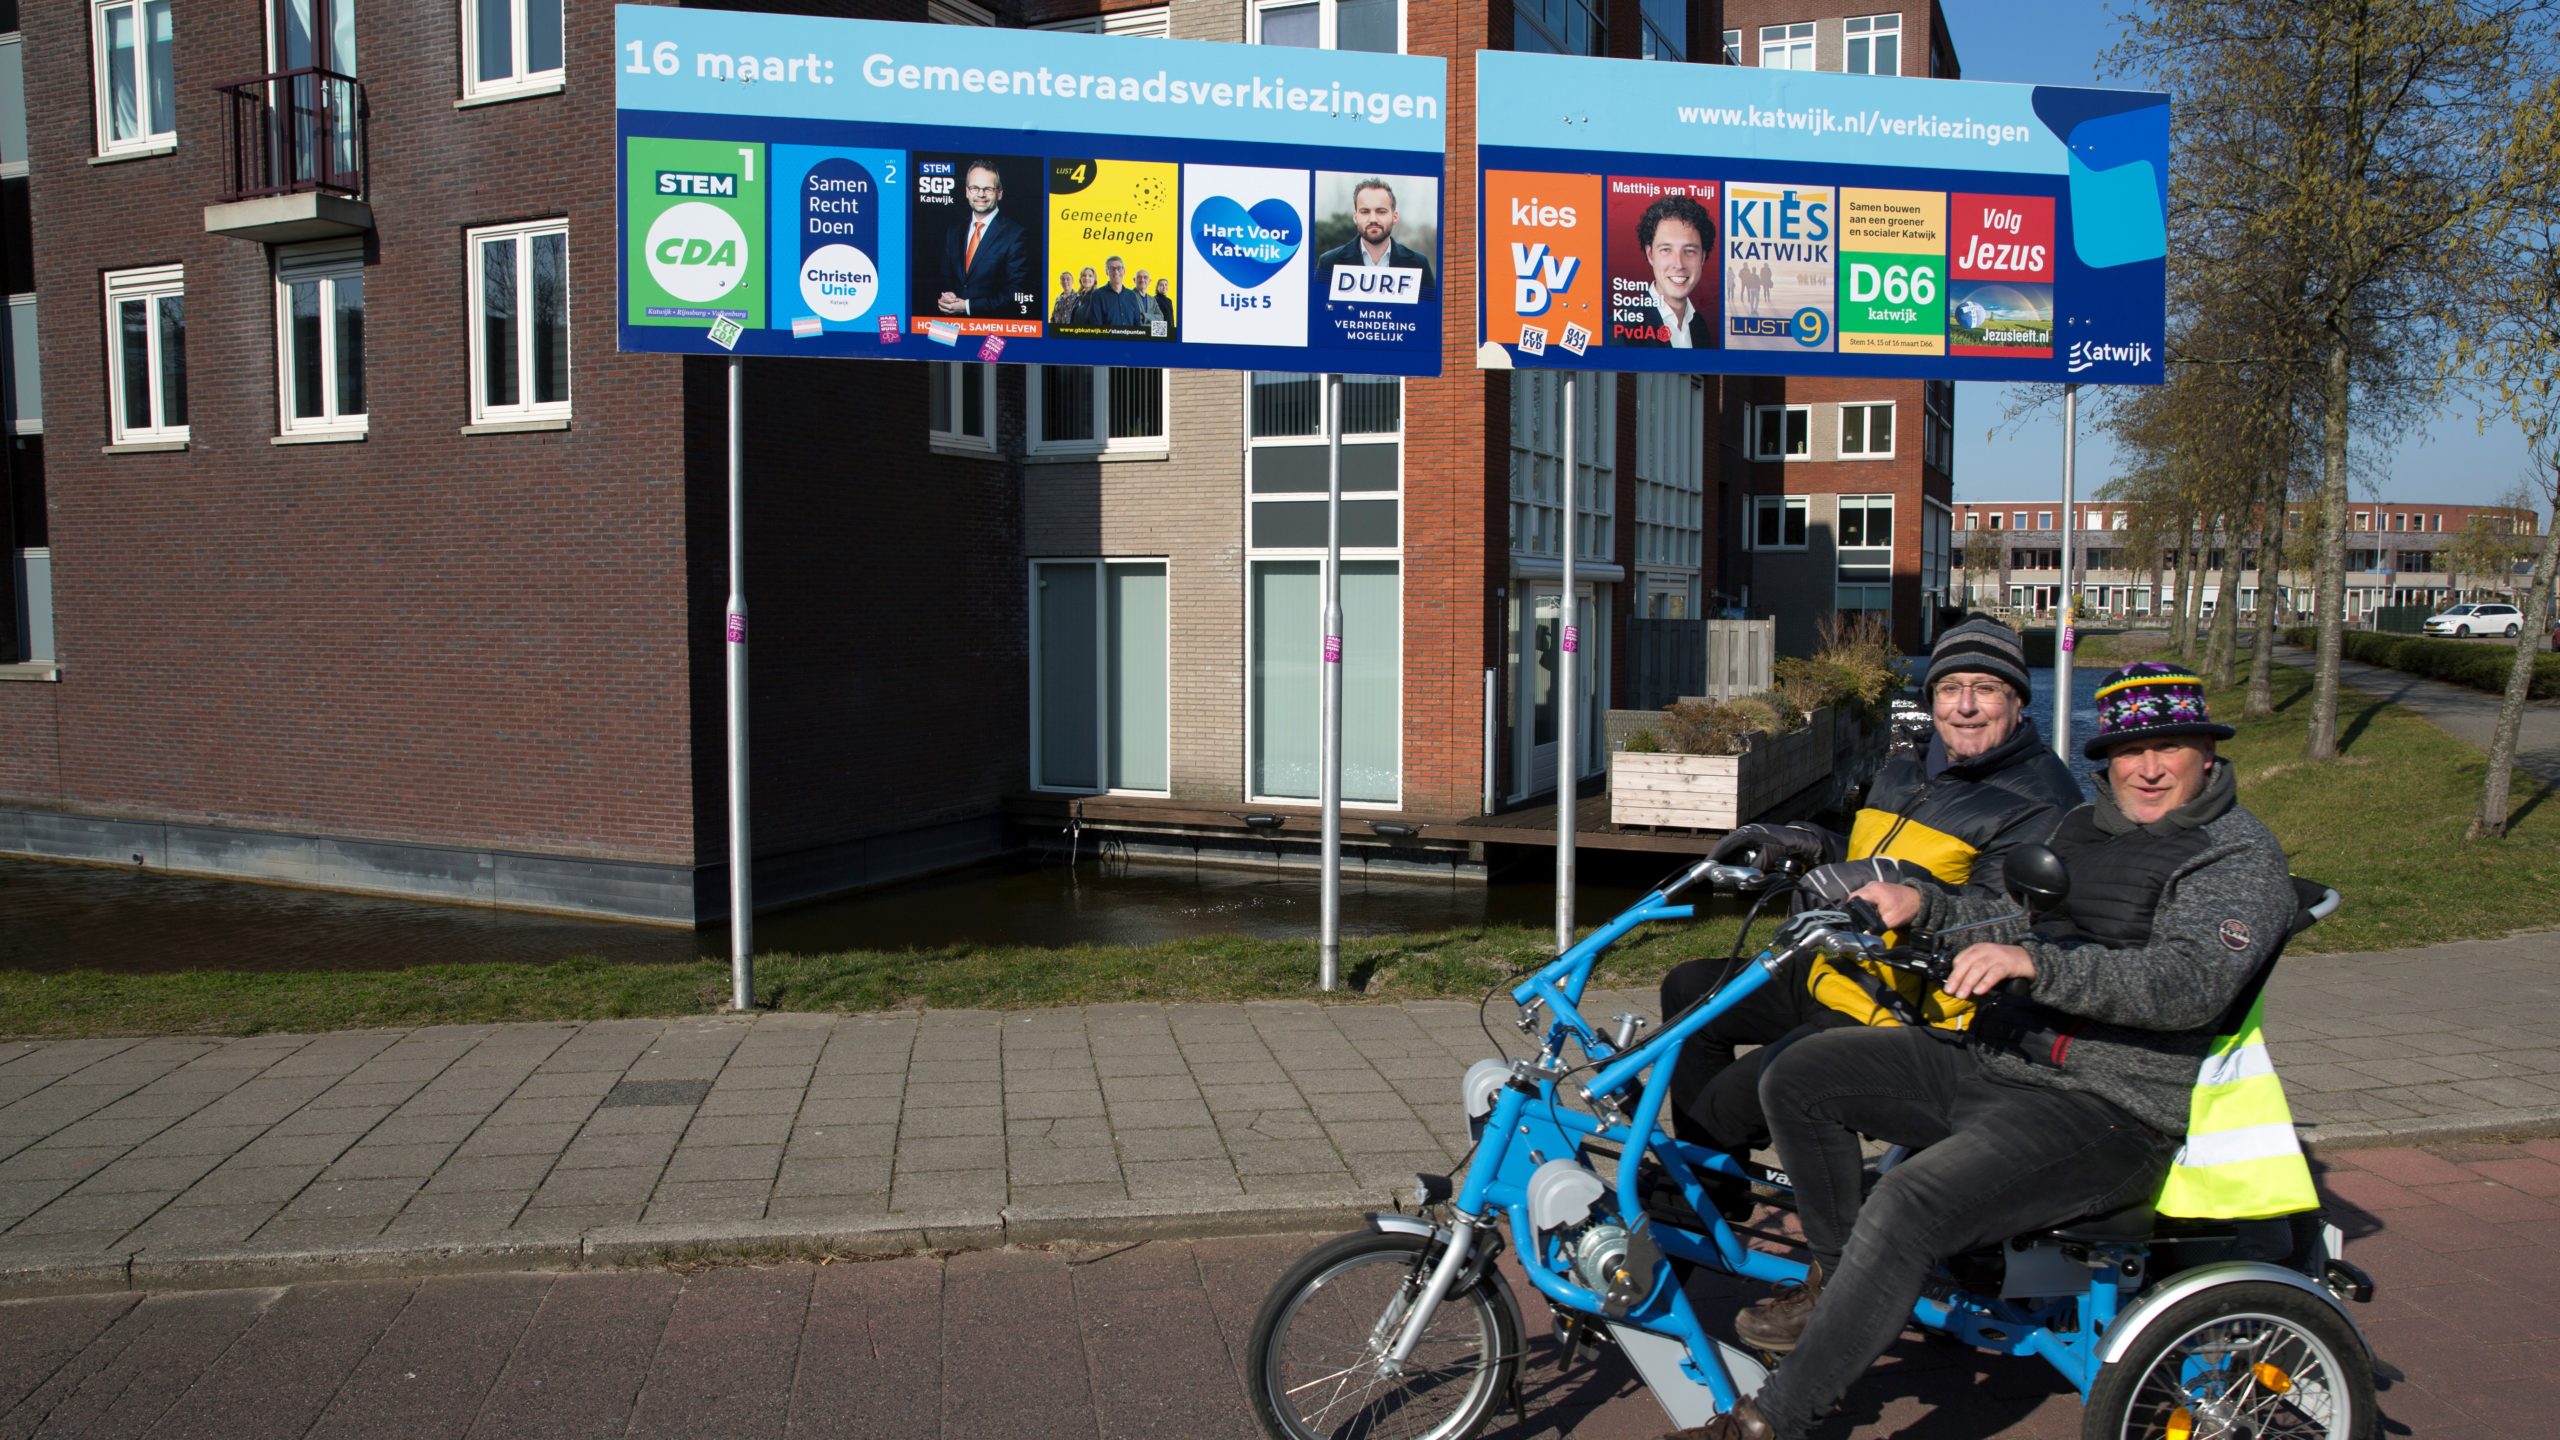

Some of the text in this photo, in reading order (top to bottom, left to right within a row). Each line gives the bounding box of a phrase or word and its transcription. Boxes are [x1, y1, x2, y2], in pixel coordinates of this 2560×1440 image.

[625, 39, 1437, 124] 16 maart: Gemeenteraadsverkiezingen
[1678, 104, 2030, 146] www.katwijk.nl/verkiezingen
[738, 148, 754, 181] 1
[923, 164, 951, 173] STEM
[885, 165, 897, 184] 2
[1070, 164, 1087, 184] 4
[660, 173, 733, 195] STEM
[809, 175, 868, 193] Samen
[919, 176, 955, 194] SGP
[1613, 182, 1714, 200] Matthijs van Tuijl
[809, 197, 859, 214] Recht
[920, 195, 954, 206] Katwijk
[1849, 202, 1921, 214] Samen bouwen
[1061, 208, 1138, 223] Gemeente
[1511, 197, 1577, 228] kies
[1731, 199, 1829, 242] KIES
[809, 218, 854, 235] Doen
[1849, 216, 1924, 227] aan een groener
[1984, 208, 2022, 235] Volg
[1083, 227, 1153, 245] Belangen
[1203, 223, 1290, 240] Hart Voor
[1863, 228, 1900, 238] socialer
[1902, 229, 1936, 241] Katwijk
[655, 238, 736, 267] CDA
[1212, 243, 1281, 262] Katwijk
[1731, 241, 1829, 263] KATWIJK
[1959, 235, 2046, 272] Jezus
[807, 269, 872, 283] Christen
[1338, 272, 1413, 294] DURF
[1613, 277, 1649, 291] Stem
[1850, 263, 1936, 305] D66
[821, 284, 857, 296] Unie
[1014, 292, 1034, 304] lijst
[1221, 293, 1272, 312] Lijst 5
[1613, 293, 1664, 308] Sociaal
[1020, 306, 1028, 314] 3
[1359, 310, 1392, 320] MAAK
[1613, 309, 1645, 323] Kies
[1868, 307, 1917, 324] katwijk
[716, 319, 738, 337] FCK
[969, 322, 1003, 332] SAMEN
[1006, 324, 1037, 333] LEVEN
[1060, 327, 1146, 336] www.gbkatwijk.nl/standpunten
[1334, 320, 1416, 332] VERANDERING
[1613, 324, 1657, 340] PvdA
[1731, 311, 1822, 343] LIJST 9
[713, 328, 733, 345] CDA
[1347, 331, 1404, 342] MOGELIJK
[1523, 329, 1544, 343] FCK
[1523, 338, 1542, 350] VVD
[1849, 338, 1865, 346] Stem
[1982, 328, 2049, 343] Jezusleeft.nl
[2068, 340, 2152, 373] Katwijk
[1766, 1169, 1792, 1186] va
